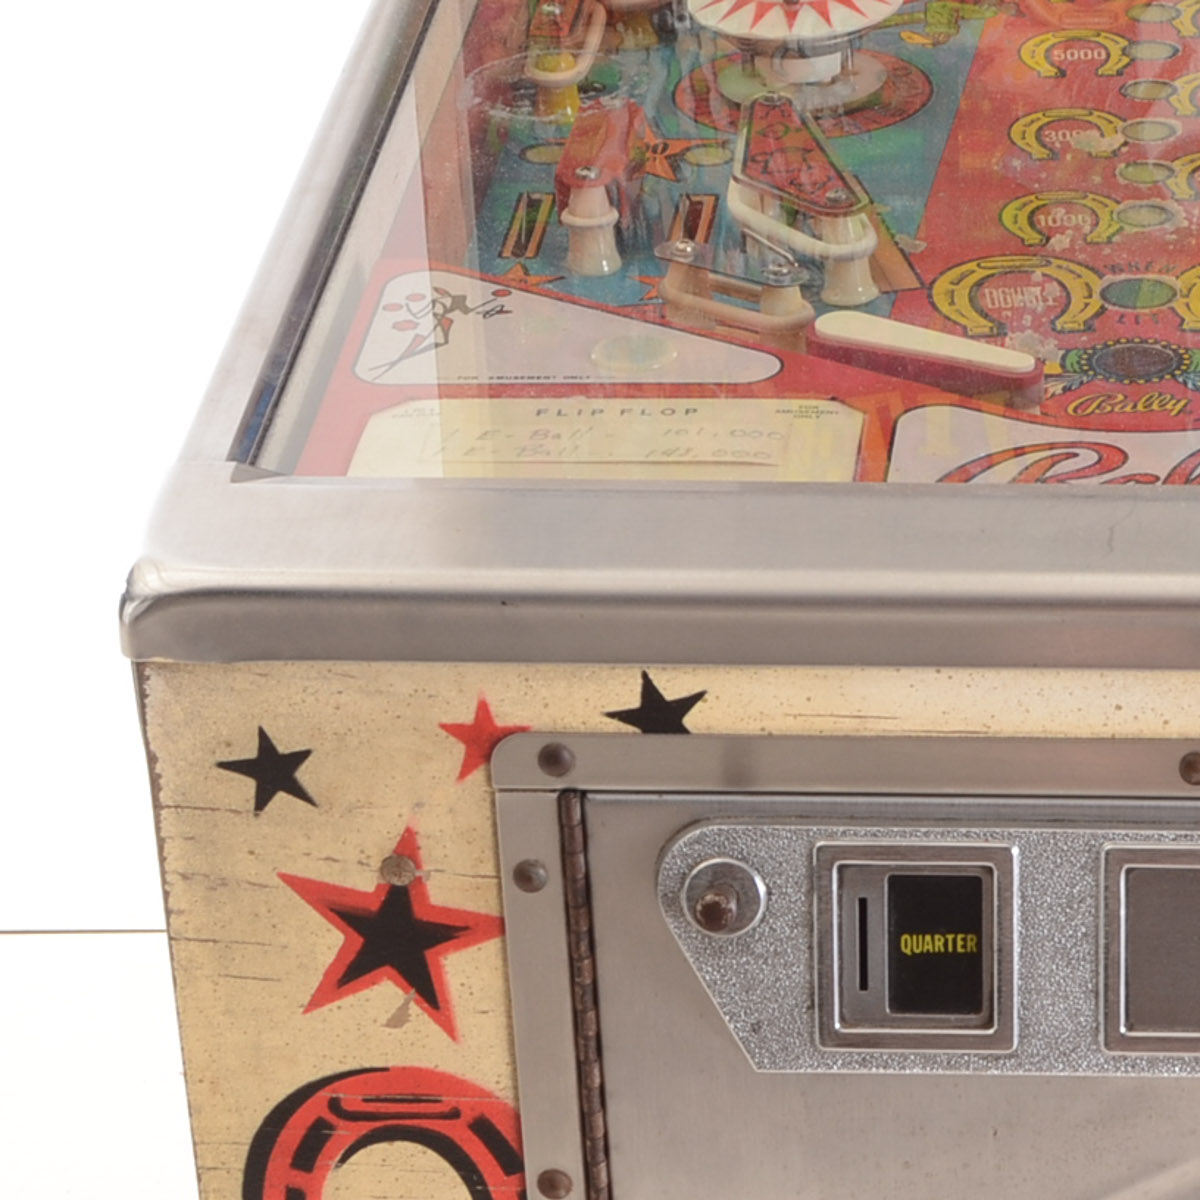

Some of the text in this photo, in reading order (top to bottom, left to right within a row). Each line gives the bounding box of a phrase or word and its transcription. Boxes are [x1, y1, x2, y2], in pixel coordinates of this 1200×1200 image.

[1052, 48, 1107, 62] 5000
[1038, 213, 1092, 228] 1000
[535, 407, 698, 417] FLIP FLOP
[1066, 392, 1191, 417] Bally
[900, 932, 978, 957] QUARTER
